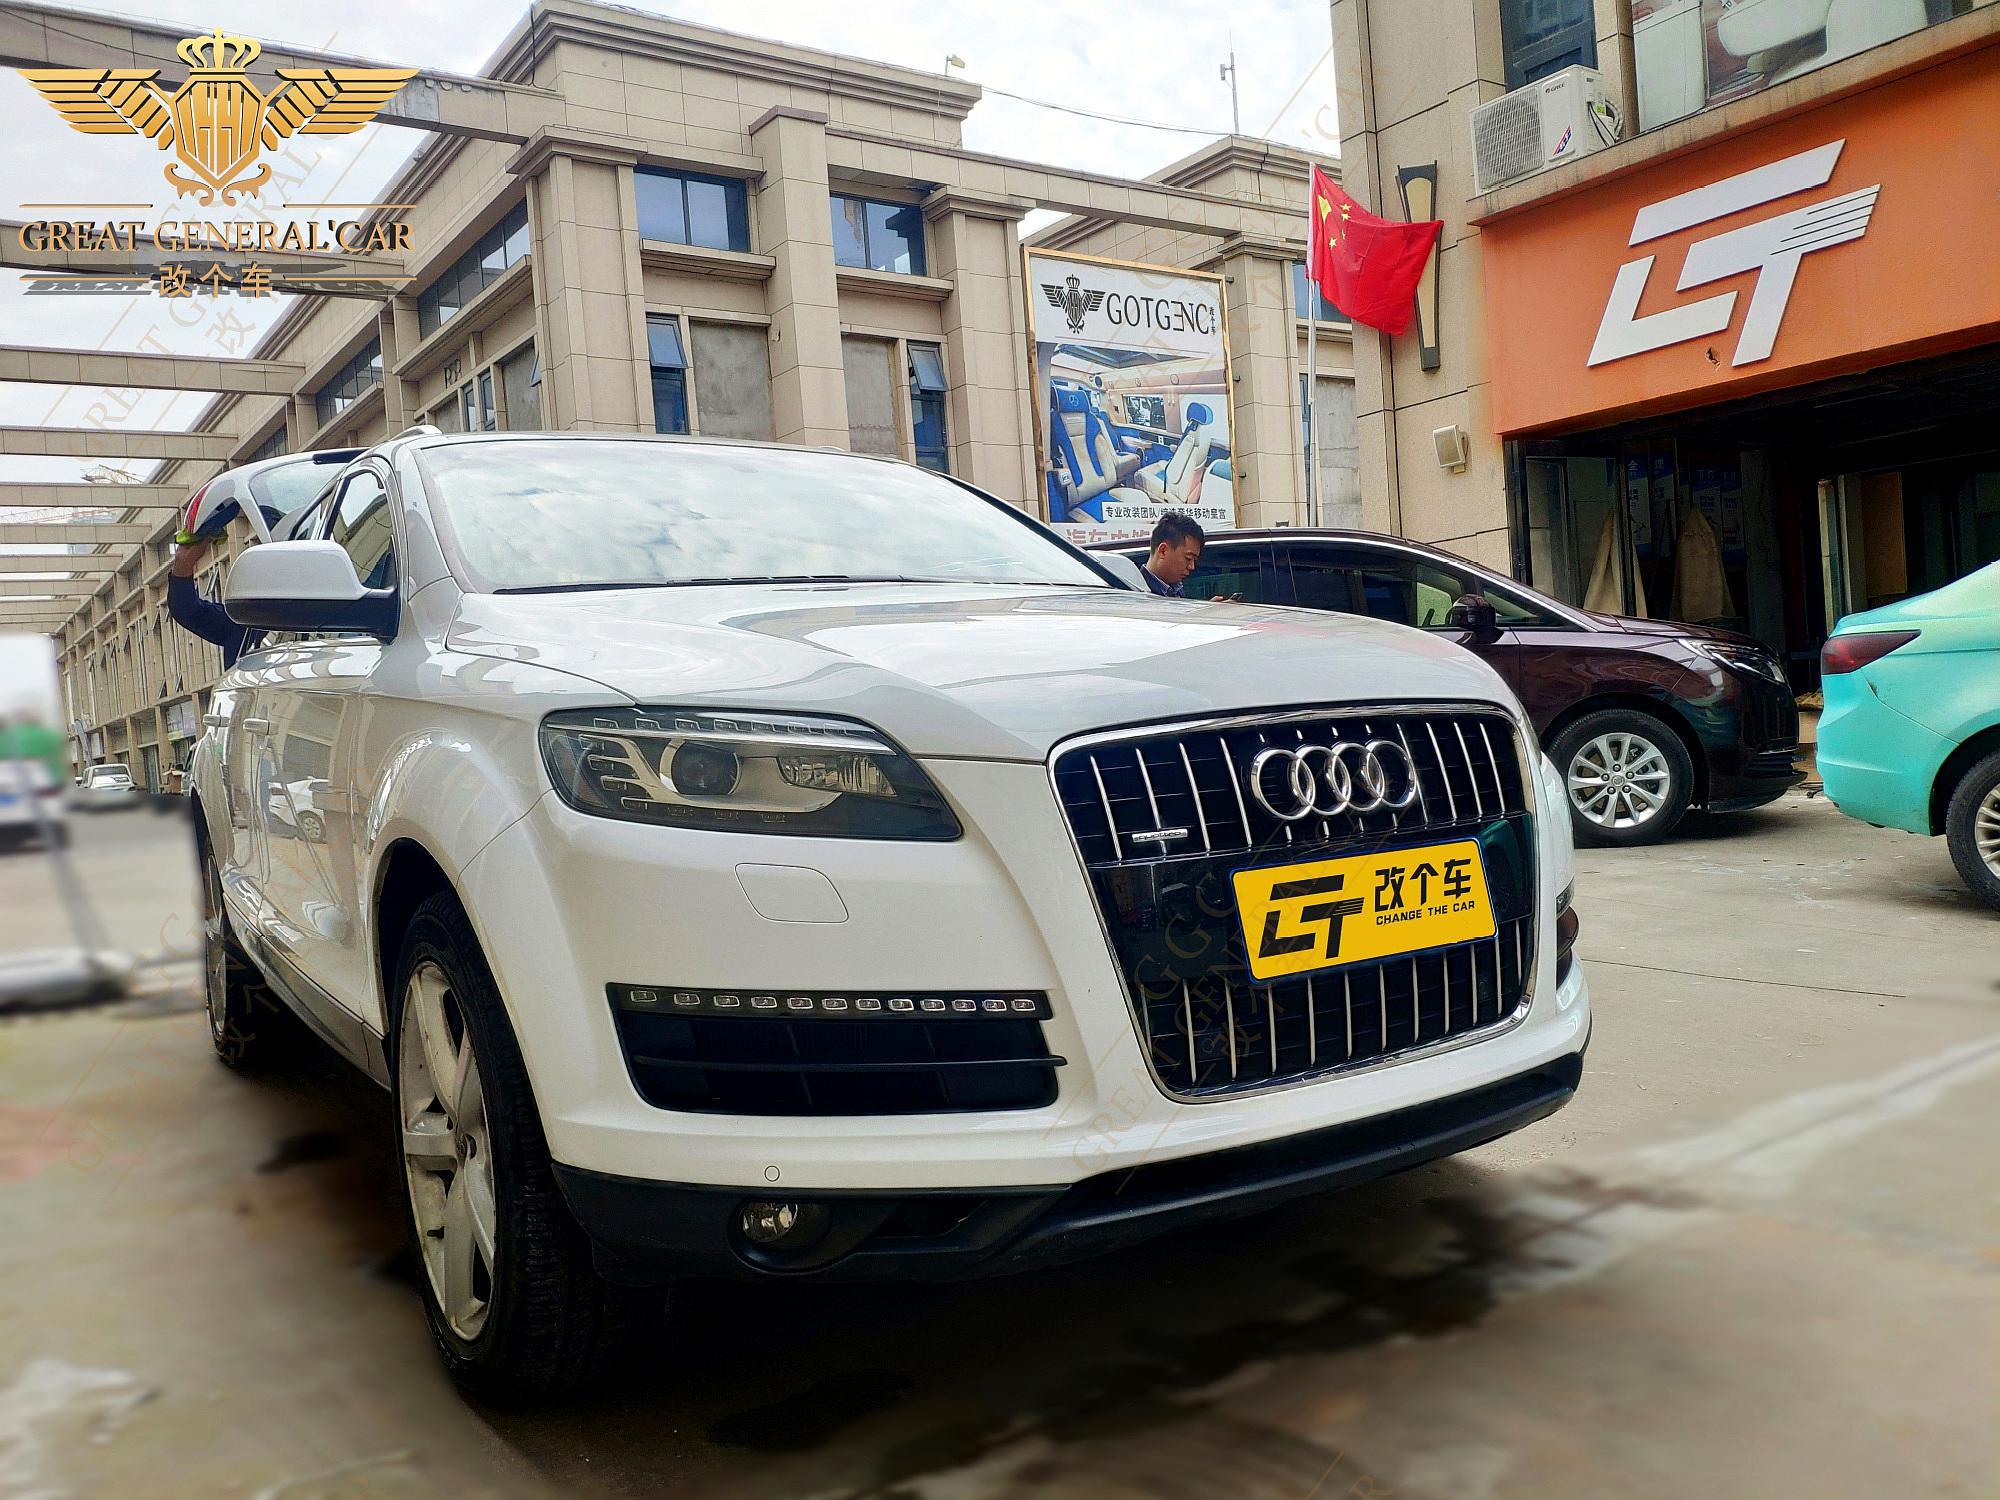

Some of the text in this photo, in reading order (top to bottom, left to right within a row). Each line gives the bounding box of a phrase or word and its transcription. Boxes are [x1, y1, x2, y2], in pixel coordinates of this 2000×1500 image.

[1375, 858, 1472, 912] 改个车
[1376, 900, 1475, 926] CHANGE THE CAR
